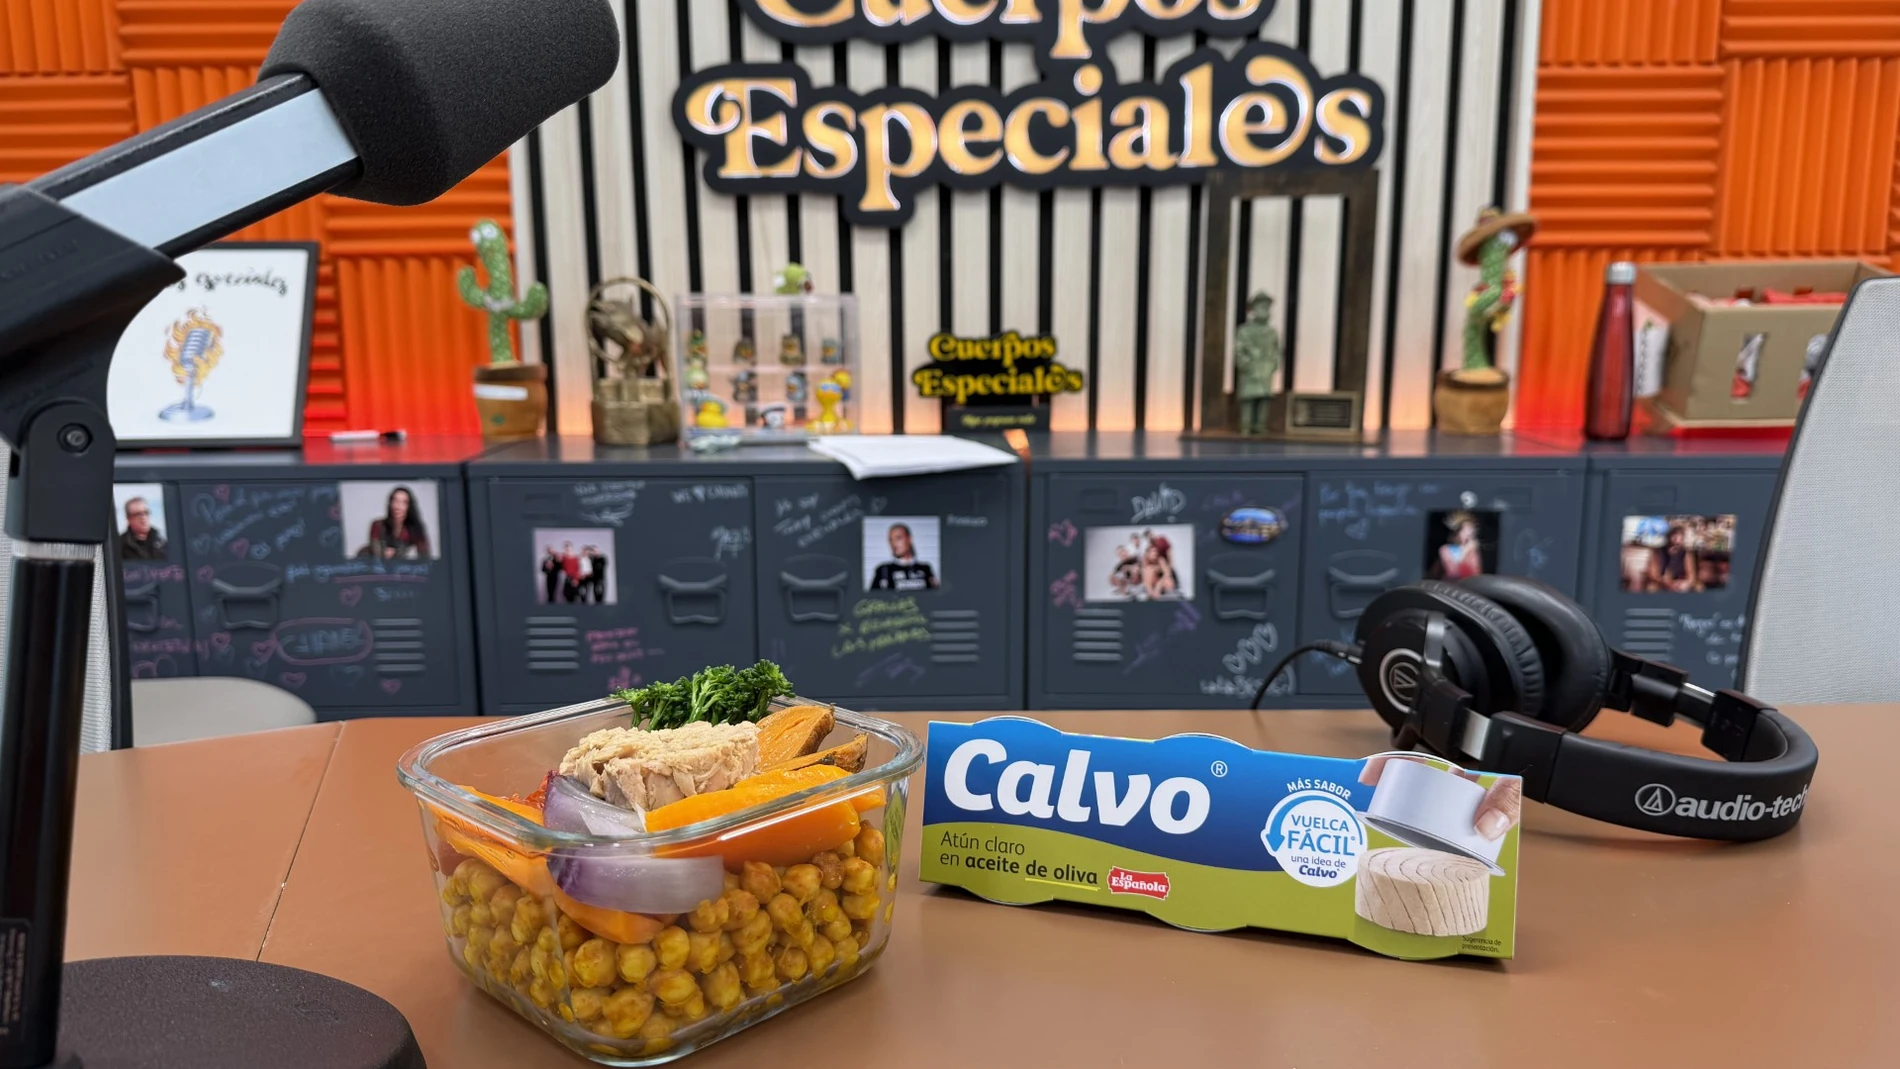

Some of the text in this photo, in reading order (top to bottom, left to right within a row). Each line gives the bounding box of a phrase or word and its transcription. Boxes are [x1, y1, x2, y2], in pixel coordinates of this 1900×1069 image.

[686, 55, 1371, 212] Especiales
[929, 331, 1056, 367] Cuerpos
[912, 363, 1083, 404] Especiales
[944, 738, 1211, 835] Calvo
[1286, 777, 1352, 800] MÁS SABOR
[1291, 814, 1349, 832] VUELCA
[940, 830, 1025, 855] Atún claro
[1287, 829, 1355, 856] FÁCIL
[940, 852, 1098, 885] en aceite de oliva
[1290, 855, 1346, 868] una idea de
[1298, 865, 1338, 879] Calvo
[1111, 876, 1167, 892] Española
[1119, 871, 1133, 881] La
[1493, 938, 1502, 946] de
